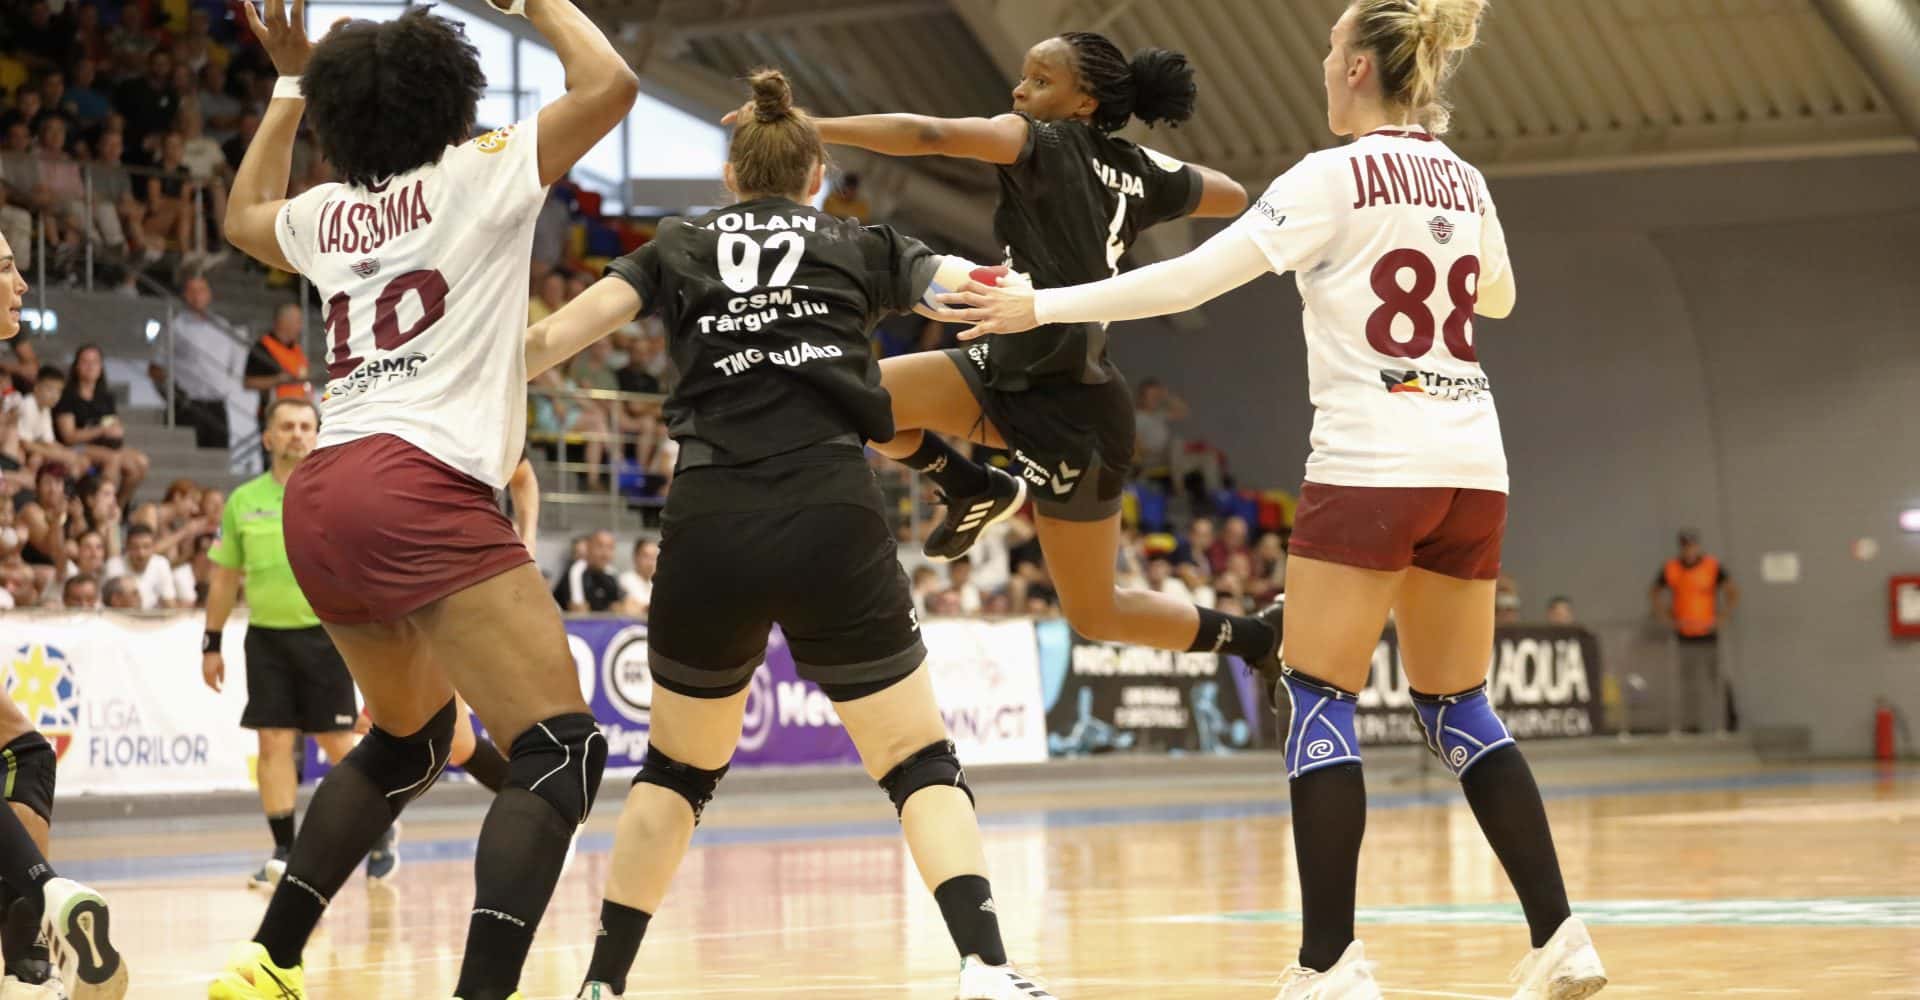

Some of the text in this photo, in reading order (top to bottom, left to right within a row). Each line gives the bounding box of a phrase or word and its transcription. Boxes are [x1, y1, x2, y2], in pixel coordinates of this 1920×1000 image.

[683, 212, 816, 232] OLAN
[697, 300, 829, 333] Târgu Jiu
[728, 288, 792, 313] CSM
[1365, 248, 1480, 362] 88
[325, 269, 450, 379] 10
[714, 342, 842, 376] TMG GUARD
[1495, 638, 1592, 704] AQUA
[87, 698, 142, 731] LIGA
[89, 734, 209, 768] FLORILOR
